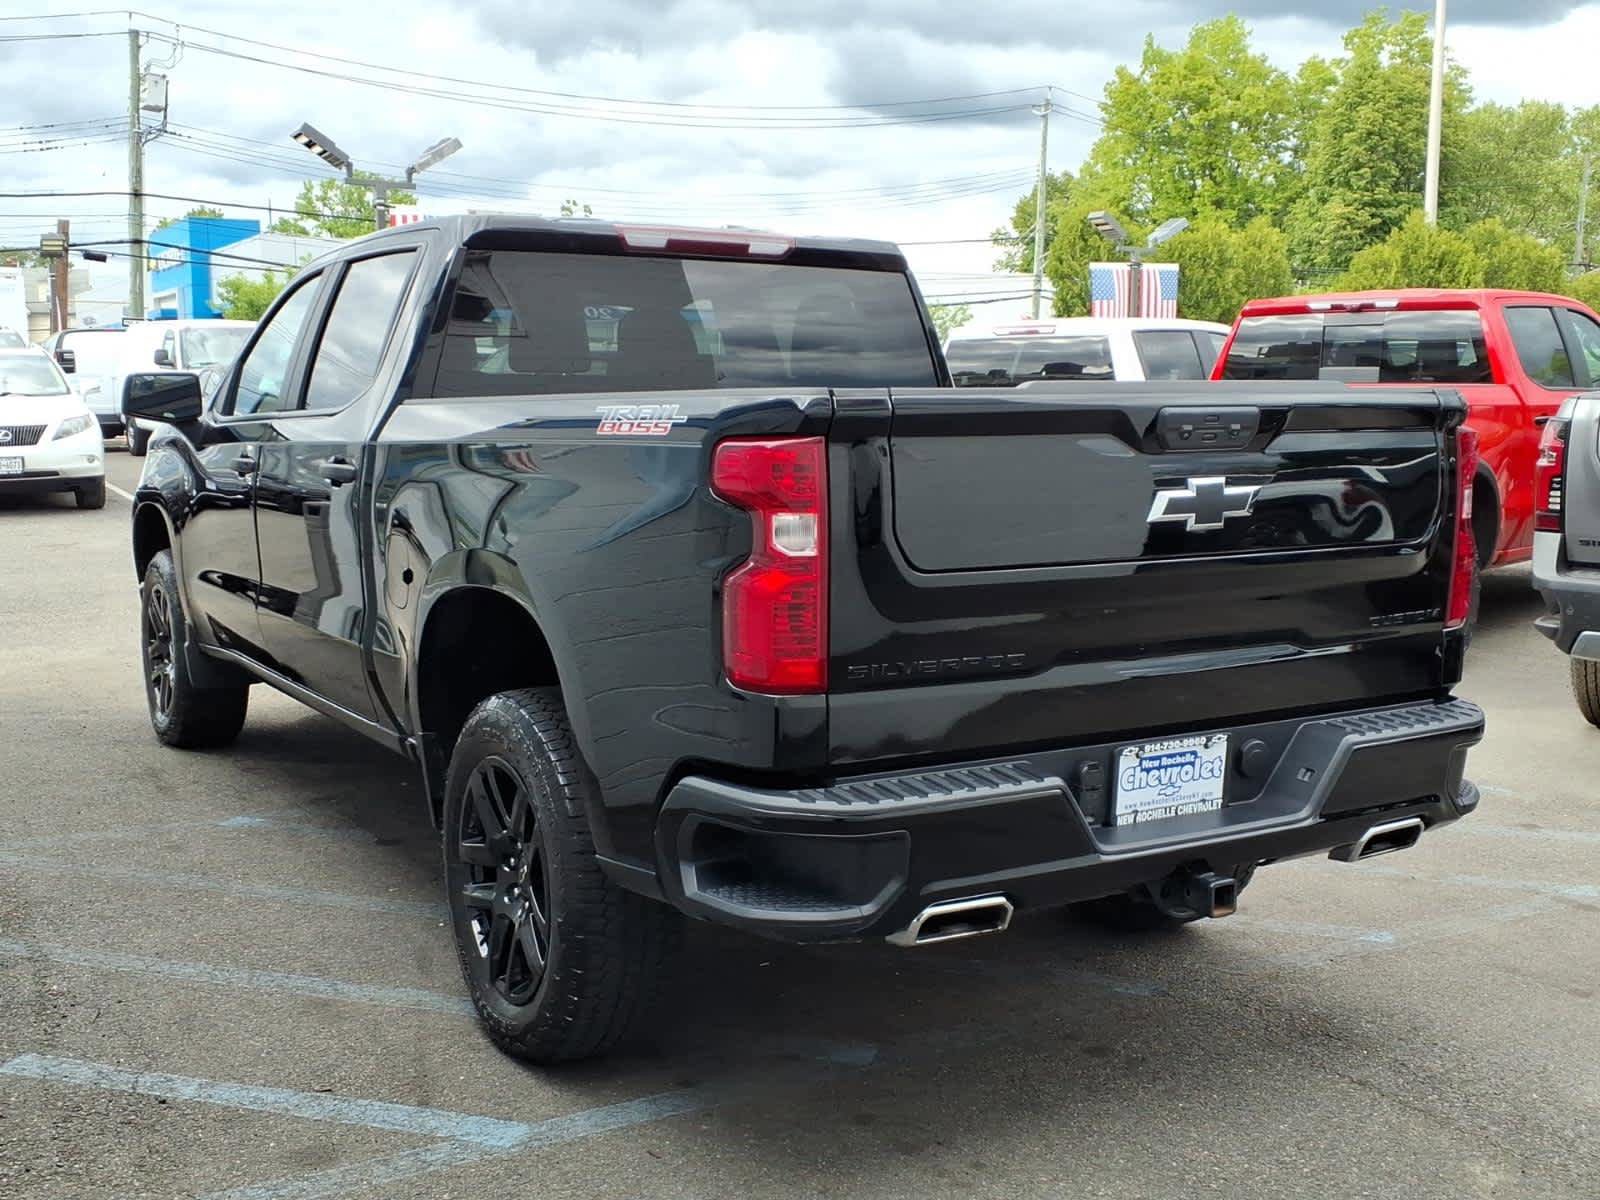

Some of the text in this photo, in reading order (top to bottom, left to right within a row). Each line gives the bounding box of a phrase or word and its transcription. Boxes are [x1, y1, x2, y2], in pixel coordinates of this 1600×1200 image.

[595, 404, 688, 423] TRAIL
[596, 421, 673, 436] BOSS
[847, 653, 1026, 679] SILVERADO
[1141, 753, 1195, 769] New Rochelle
[1120, 756, 1223, 791] Chevrolet
[1117, 799, 1223, 826] NEW ROCHELLE CHEVROLET
